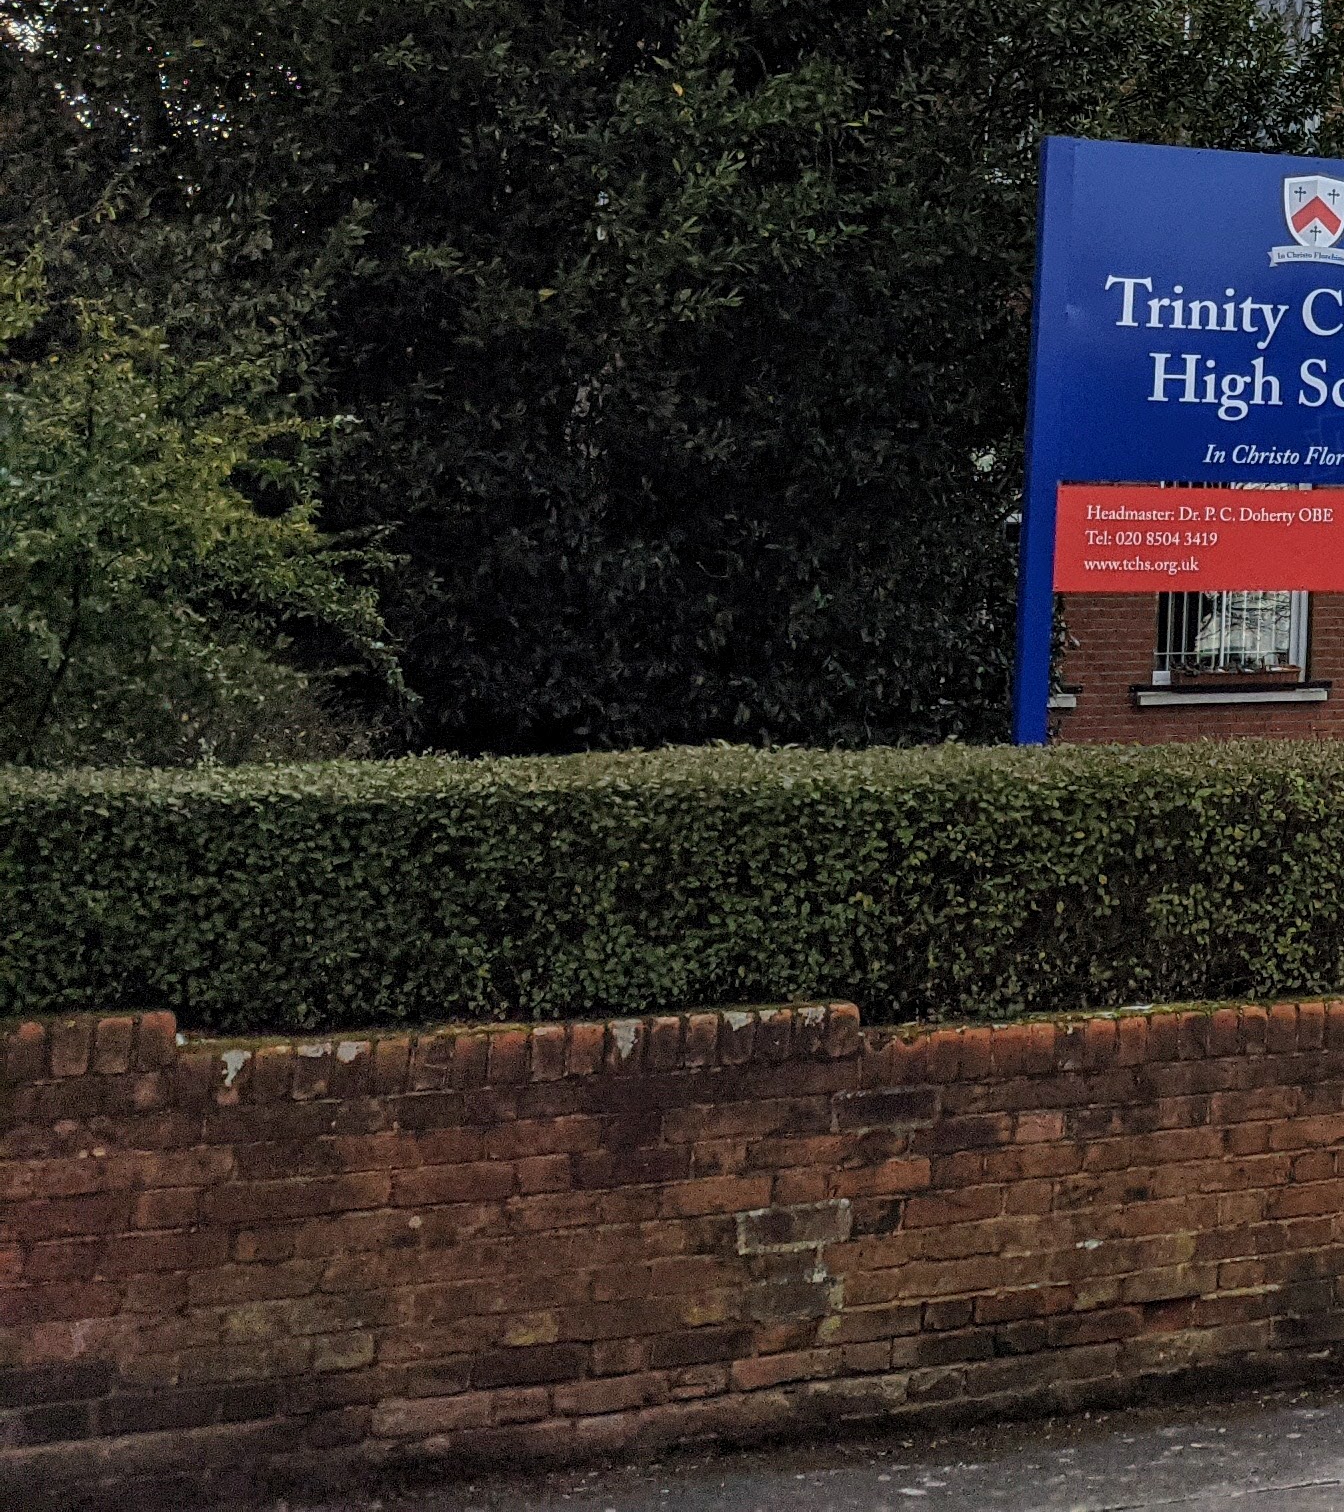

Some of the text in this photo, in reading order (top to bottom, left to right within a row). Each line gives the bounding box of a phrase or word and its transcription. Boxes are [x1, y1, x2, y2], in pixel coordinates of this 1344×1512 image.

[1104, 274, 1290, 350] Trinity
[1146, 351, 1283, 422] High
[1202, 444, 1226, 464] In
[1231, 444, 1300, 466] Christo
[1086, 505, 1334, 526] Headmaster: Dr. P. C. Doherty OBE
[1085, 530, 1218, 546] Tel: 020 8504 3419
[1084, 556, 1200, 575] www.tchs.org.uk
